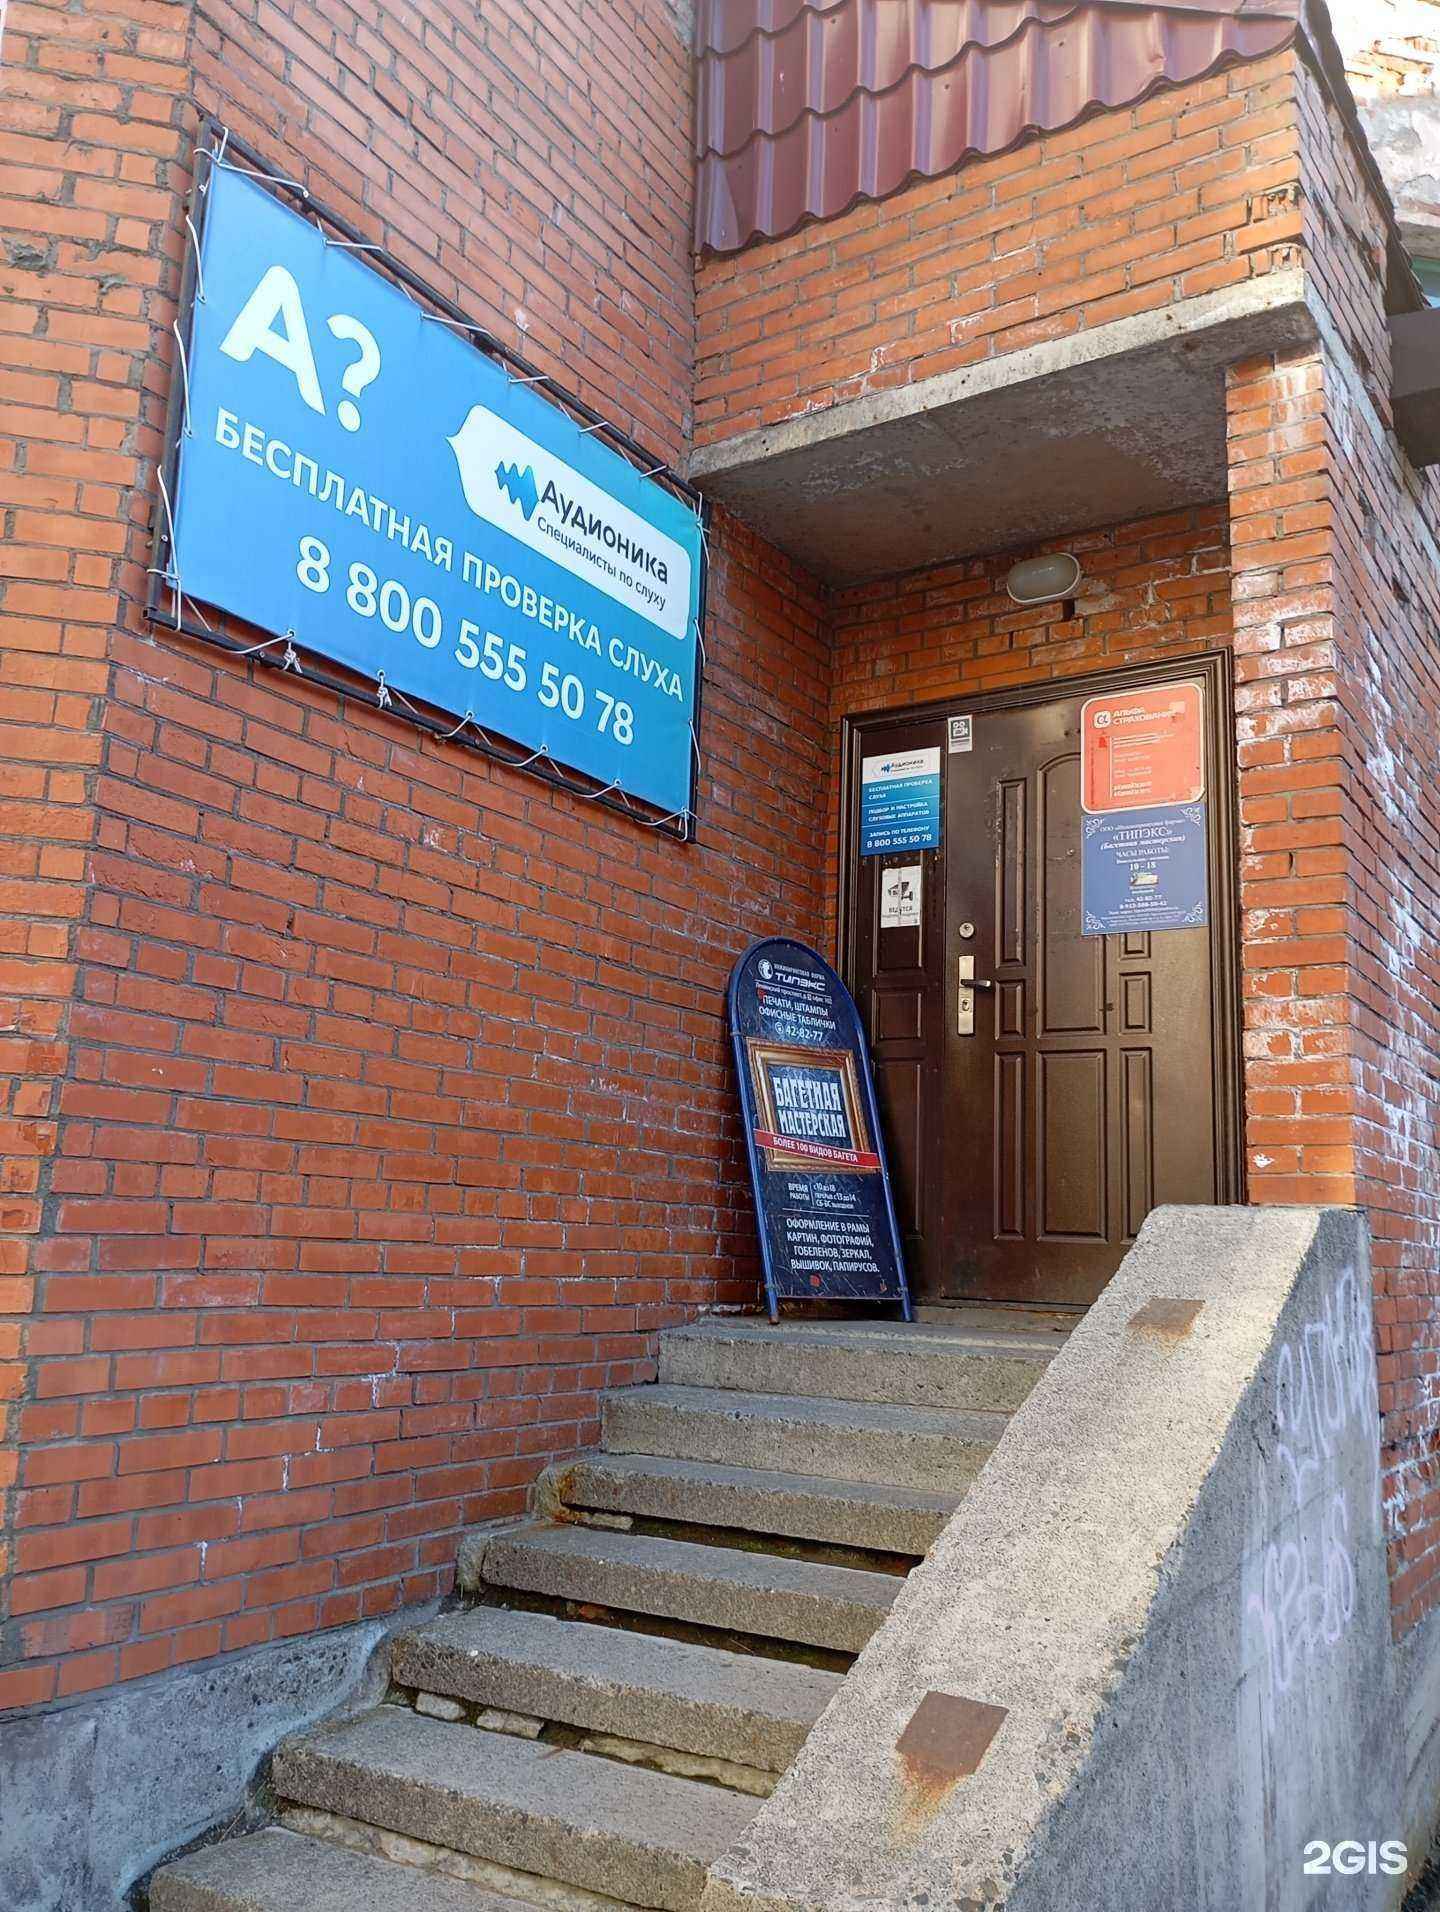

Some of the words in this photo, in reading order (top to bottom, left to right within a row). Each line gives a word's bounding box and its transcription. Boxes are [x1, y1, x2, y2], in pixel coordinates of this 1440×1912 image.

[219, 264, 381, 432] А?
[541, 480, 669, 585] Аудионика
[215, 407, 453, 573] БЕСПЛАТНАЯ
[461, 553, 602, 656] ПРОВЕРКА
[608, 637, 684, 703] СЛУХА
[537, 516, 617, 577] Специалисты
[619, 569, 633, 588] по
[635, 580, 667, 612] слуху
[296, 534, 331, 594] 8
[346, 561, 443, 649] 800
[455, 621, 527, 692] 555
[538, 665, 585, 720] 50
[593, 689, 636, 746] 78
[874, 839, 890, 847] 800
[892, 837, 907, 845] 555
[909, 835, 920, 843] 50
[775, 972, 826, 991] ТИПЭКС
[759, 1006, 798, 1022] ОФИСНЫЕ
[798, 1015, 836, 1031] ТАБЛИЧКИ
[794, 1002, 828, 1017] ШТАМПЫ
[786, 1025, 823, 1041] 42-82-77
[773, 1077, 842, 1111] БАГЕТНАЯ
[778, 1109, 847, 1138] МАСТЕРСКАЯ
[773, 1136, 796, 1150] БОЛЕЕ
[797, 1143, 808, 1152] 100
[809, 1144, 832, 1157] ВИДОВ
[833, 1150, 858, 1162] БАГЕТА
[786, 1218, 840, 1232] ОФОРМЛЕНИЕ
[841, 1222, 846, 1230] В
[847, 1223, 870, 1233] РАМЫ
[786, 1231, 820, 1244] КАРТИН,
[820, 1233, 874, 1247] ФОТОГРАФИЙ,
[794, 1245, 841, 1260] ГОБЕЛЕНОВ,
[841, 1248, 872, 1261] ЗЕРКАЛ,
[791, 1259, 832, 1273] ВЫШИВОК,
[832, 1261, 880, 1273] ПАПИРУСОВ.
